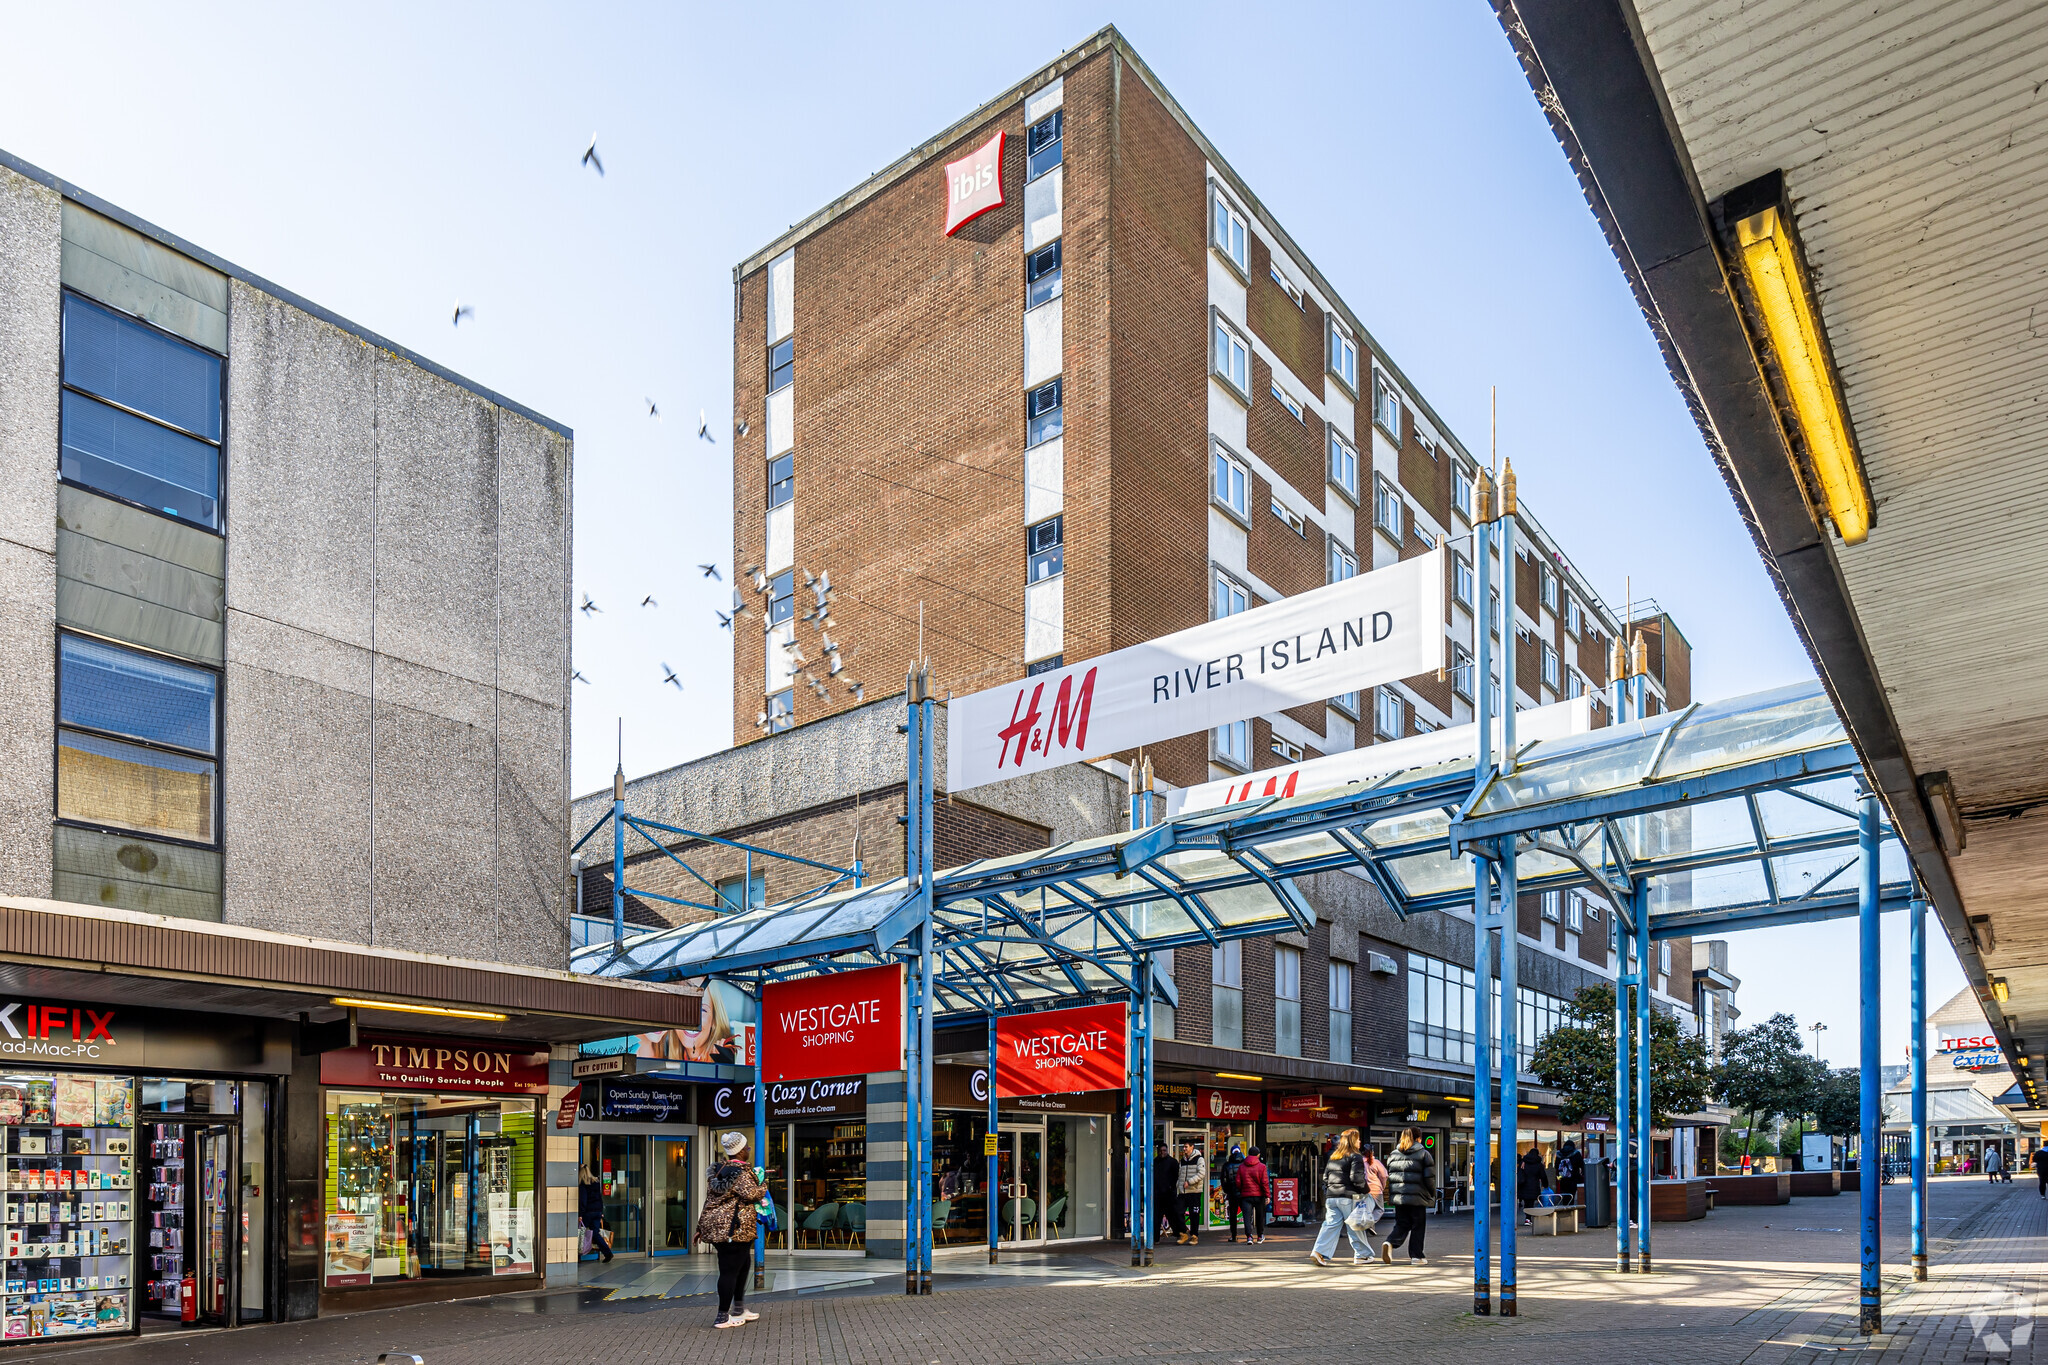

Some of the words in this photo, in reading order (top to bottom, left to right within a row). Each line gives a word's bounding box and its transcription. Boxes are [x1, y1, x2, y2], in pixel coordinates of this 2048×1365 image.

[953, 163, 994, 205] ibis
[1153, 652, 1245, 704] RIVER
[1260, 610, 1393, 675] ISLAND
[998, 666, 1098, 769] H&M
[779, 999, 881, 1034] WESTGATE
[802, 1029, 855, 1048] SHOPPING
[1013, 1030, 1108, 1058] WESTGATE
[0, 1040, 100, 1059] ad-Mac-PC
[371, 1044, 512, 1074] TIMPSON
[578, 1064, 589, 1074] KEY
[591, 1060, 618, 1072] CUTTING
[1035, 1055, 1084, 1070] SHOPPING
[1952, 1053, 2000, 1067] extra
[379, 1073, 397, 1081] The
[400, 1074, 434, 1084] Quality
[437, 1076, 471, 1085] Service
[474, 1078, 505, 1087] People
[609, 1089, 628, 1101] Open
[628, 1089, 651, 1102] Sunday
[651, 1090, 683, 1103] 10am-4pm
[771, 1083, 807, 1105] Cozy
[809, 1079, 862, 1101] Corner
[1169, 1085, 1192, 1095] BARBERS
[613, 1102, 679, 1112] www.westgateshopping.co.uk
[774, 1107, 801, 1116] Patisserie
[816, 1105, 836, 1113] Cream
[1018, 1099, 1041, 1108] Patisserie
[1051, 1101, 1066, 1109] Cream
[1223, 1100, 1251, 1118] Express
[1277, 1189, 1294, 1201] £3
